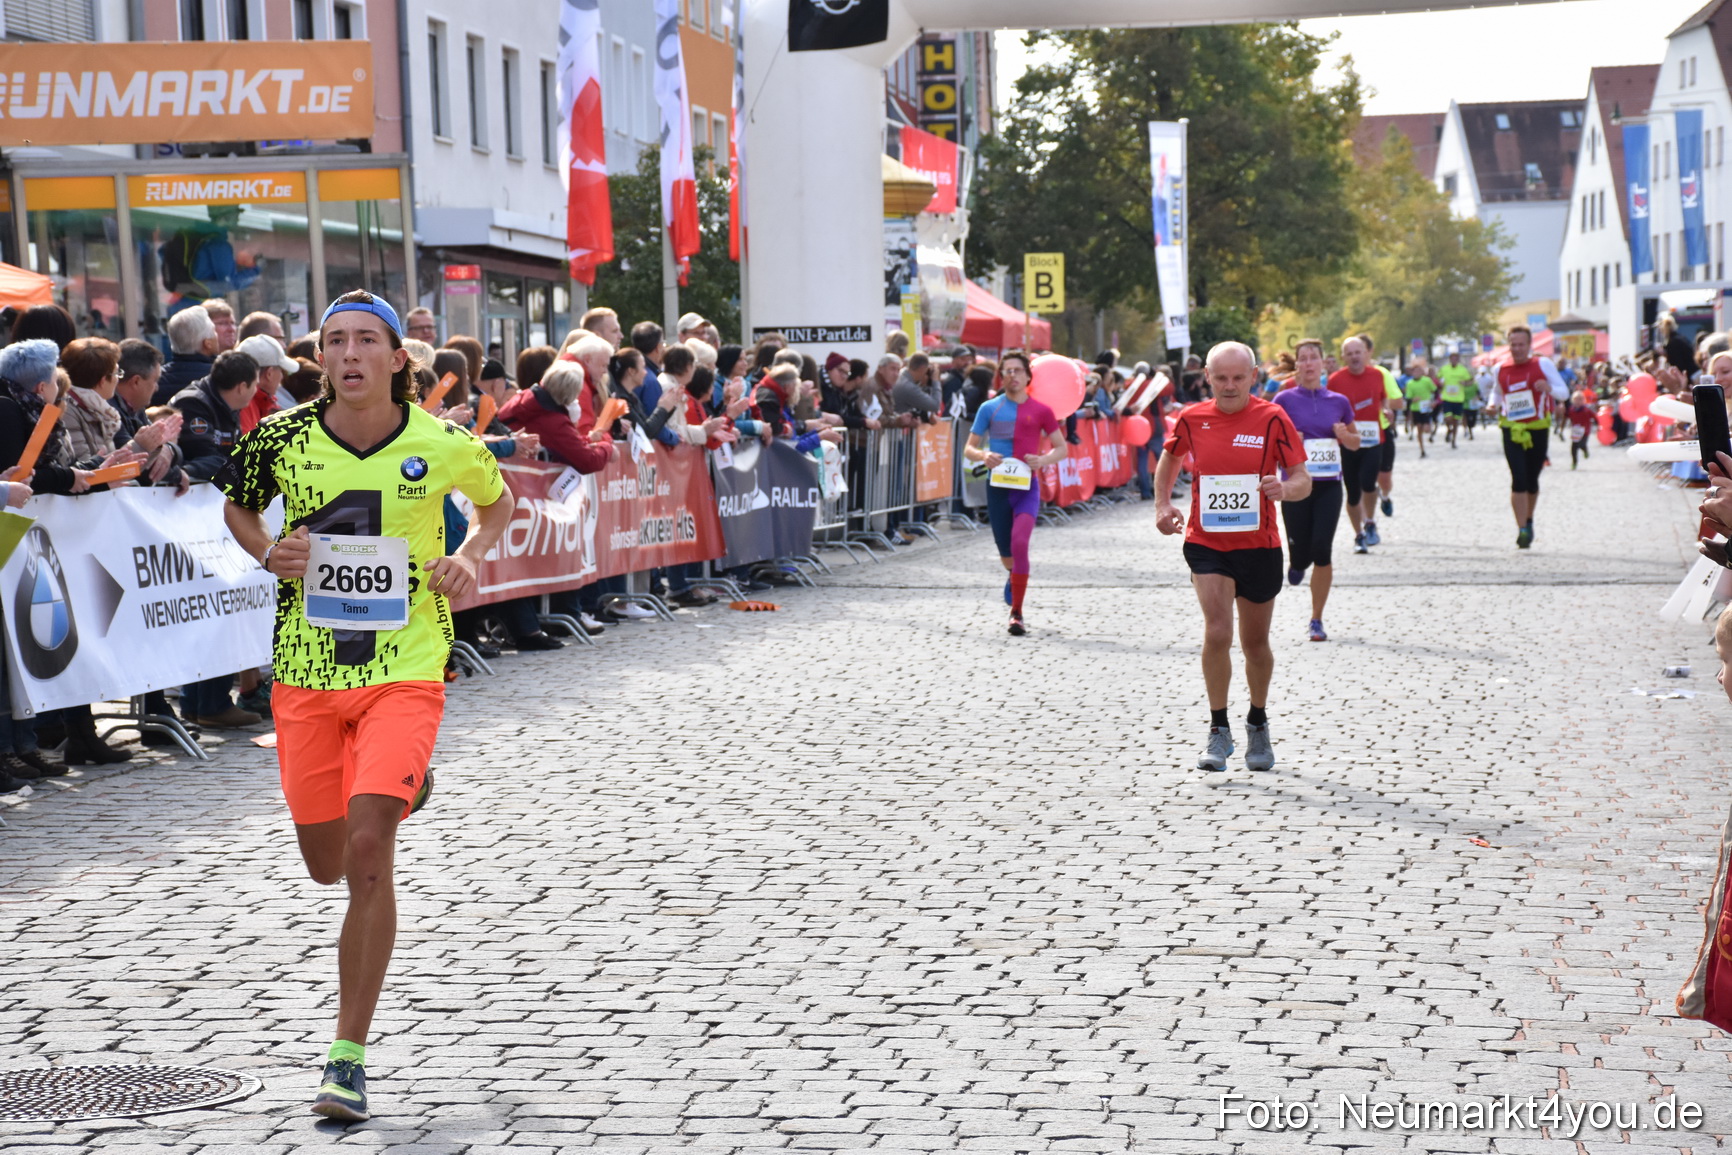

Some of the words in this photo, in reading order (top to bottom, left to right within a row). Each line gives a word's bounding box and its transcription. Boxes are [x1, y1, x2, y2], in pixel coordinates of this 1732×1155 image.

[0, 69, 353, 119] UNMARKT.DE
[146, 179, 292, 201] RUNMARKT.DE
[1030, 256, 1058, 267] Block
[1036, 272, 1054, 299] B
[1233, 434, 1264, 445] JURA
[1311, 451, 1336, 462] 2336
[1005, 465, 1018, 474] 37
[398, 484, 427, 494] Partl
[1208, 493, 1250, 510] 2332
[341, 544, 377, 553] BOCK
[132, 542, 194, 589] BMW
[318, 563, 392, 593] 2669
[141, 594, 211, 629] WENIGER
[341, 603, 369, 614] Tamo
